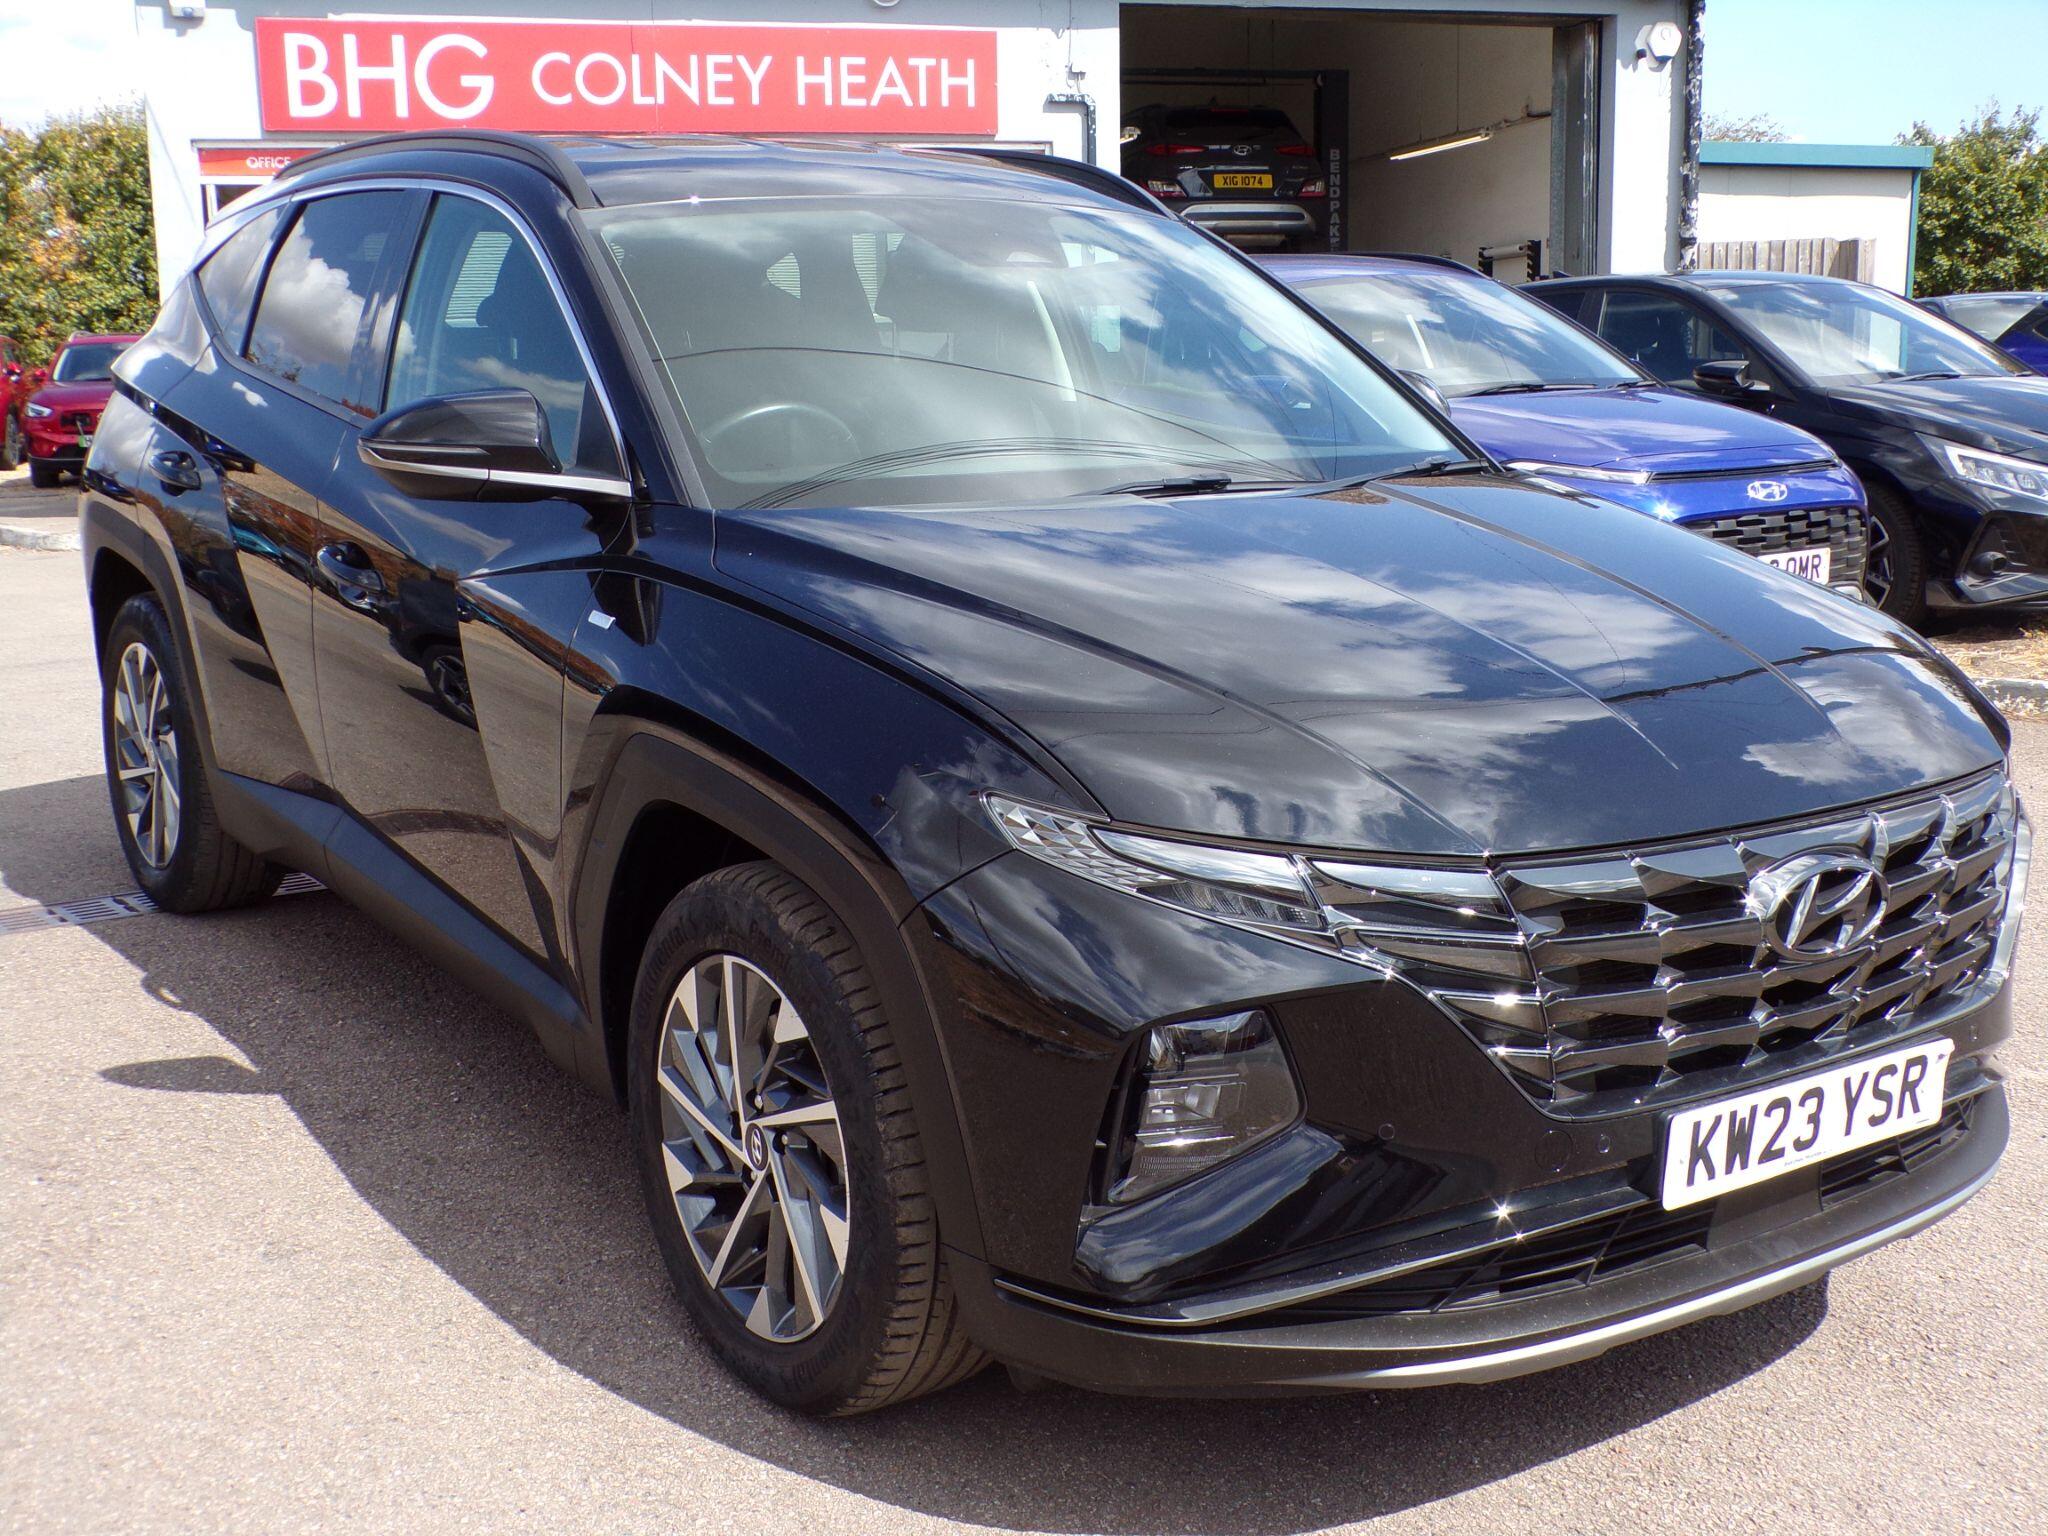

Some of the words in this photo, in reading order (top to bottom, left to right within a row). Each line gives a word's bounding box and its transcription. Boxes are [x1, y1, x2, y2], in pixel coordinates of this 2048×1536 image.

[284, 33, 494, 119] BHG
[532, 52, 772, 106] COLNEY
[796, 56, 975, 108] HEATH
[1222, 175, 1239, 186] XIG
[1686, 1086, 1825, 1187] KW23
[1844, 1054, 1928, 1137] YSR
